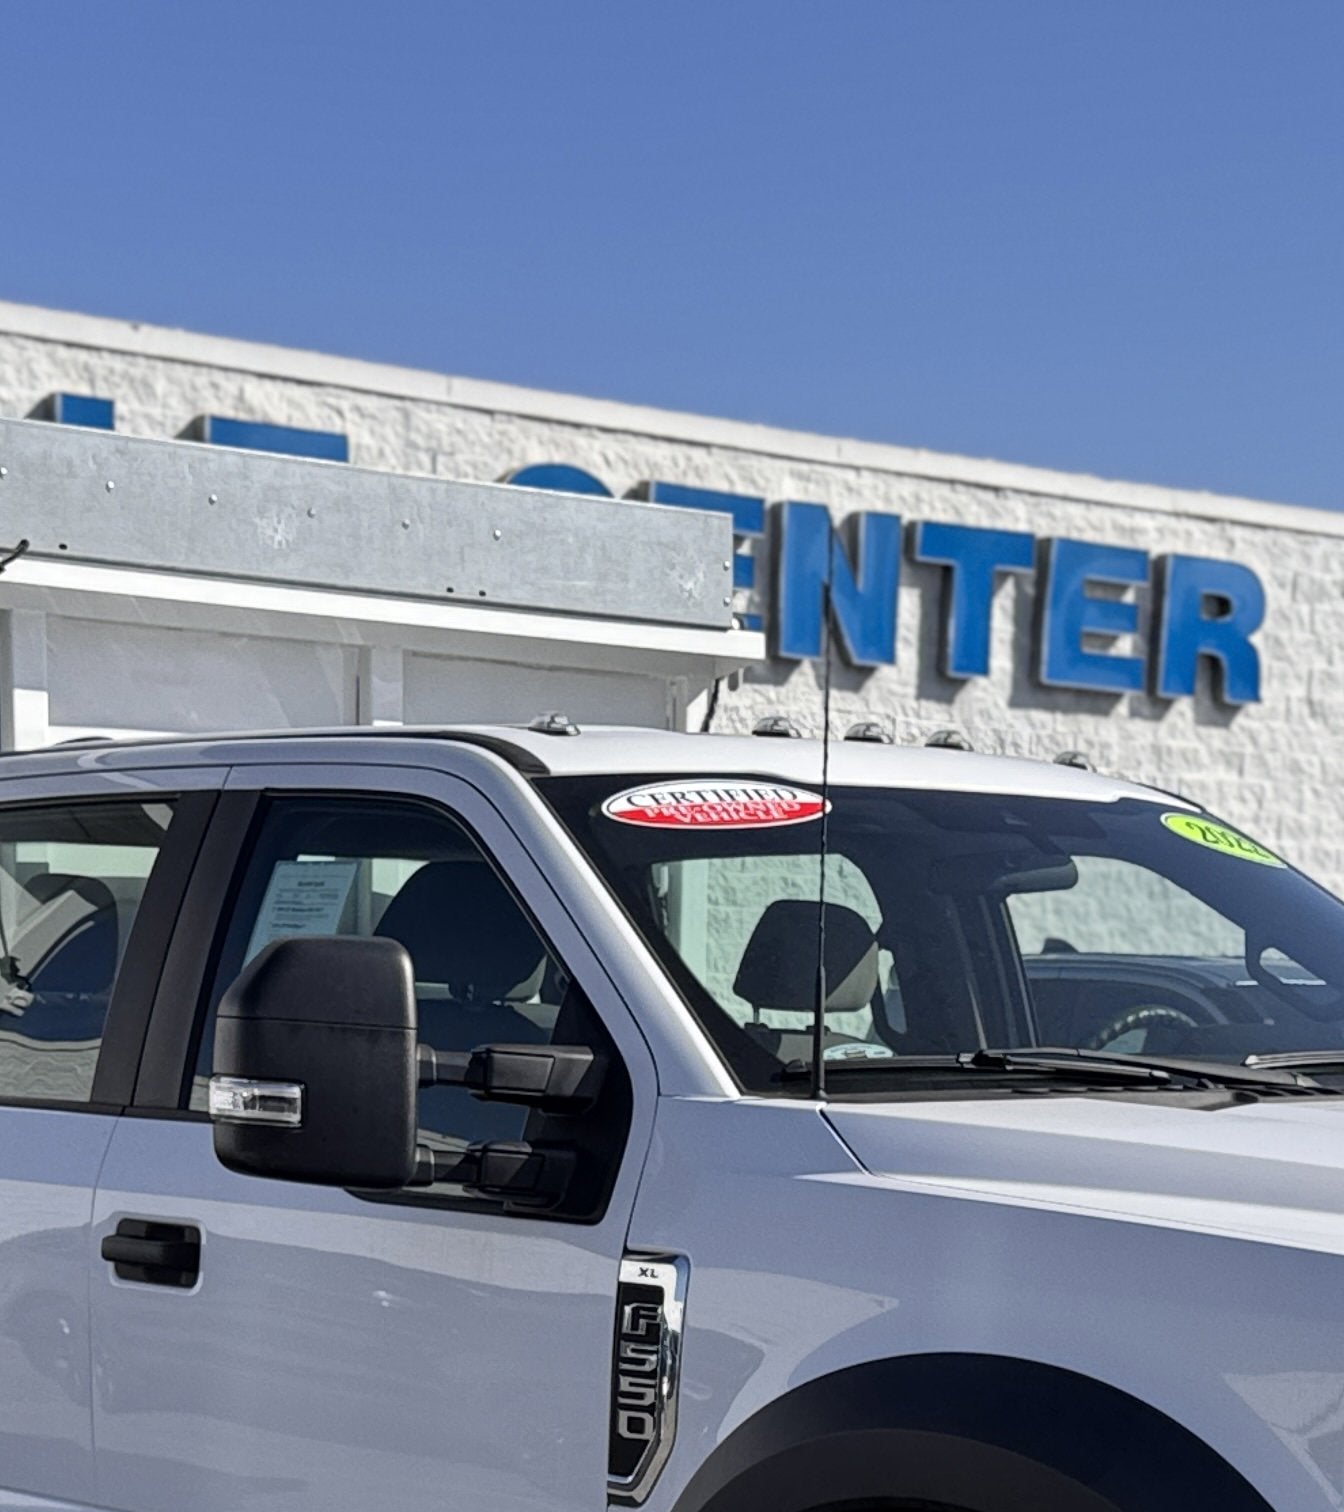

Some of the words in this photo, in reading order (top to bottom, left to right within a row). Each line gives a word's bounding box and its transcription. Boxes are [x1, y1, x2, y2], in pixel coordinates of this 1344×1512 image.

[625, 787, 799, 809] CERTIFIED
[674, 807, 785, 824] VEHICLE
[637, 1266, 659, 1279] XL
